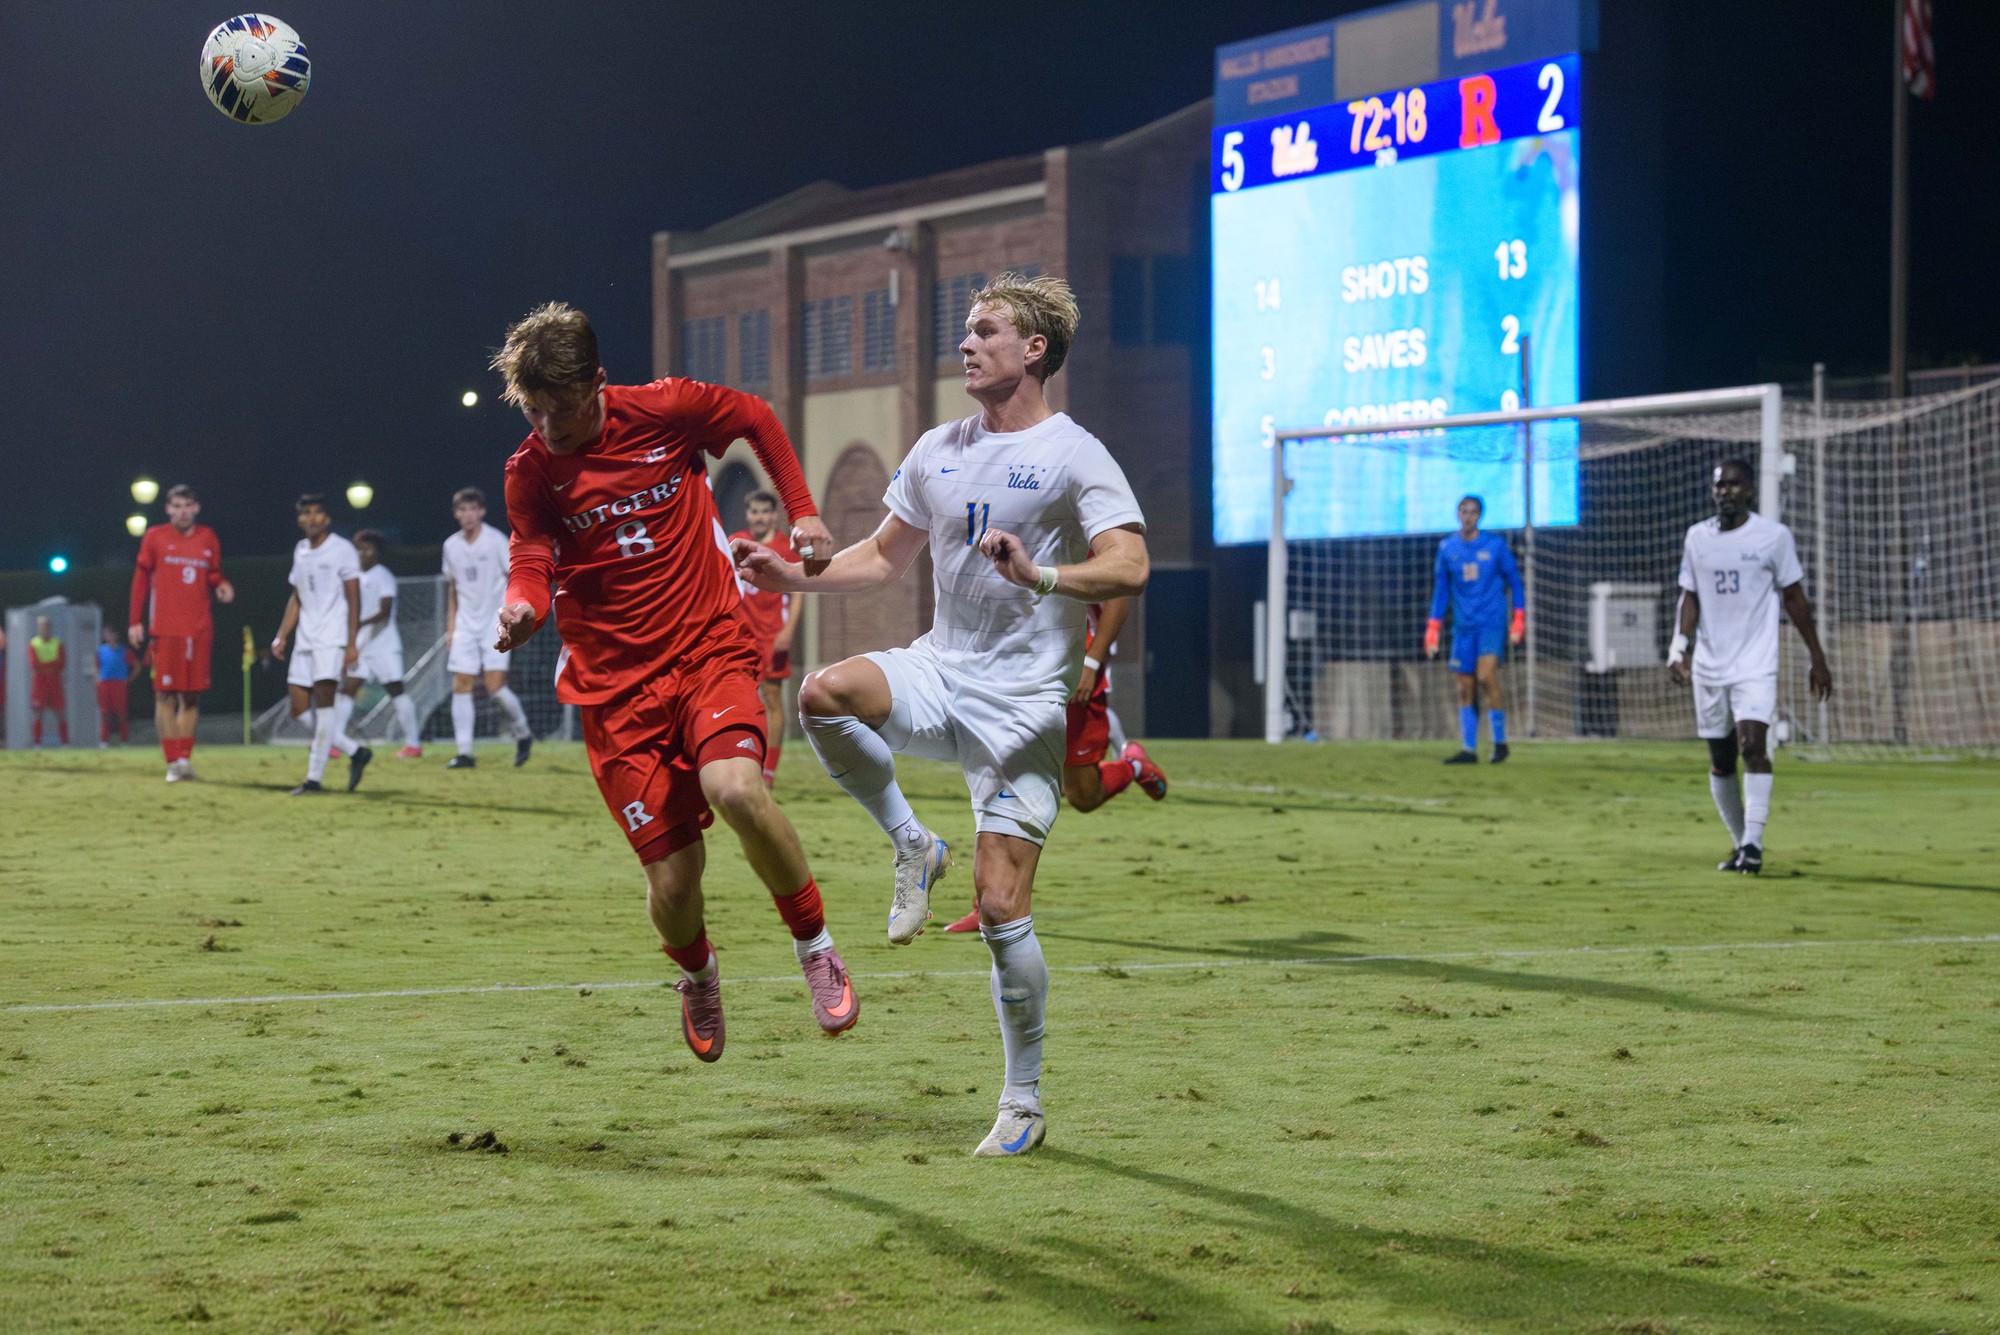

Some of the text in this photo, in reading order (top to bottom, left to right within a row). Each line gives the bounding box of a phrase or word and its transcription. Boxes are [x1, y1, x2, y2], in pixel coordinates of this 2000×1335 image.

[1221, 131, 1245, 191] 5
[1347, 88, 1427, 154] 72:18
[1459, 75, 1501, 148] R
[1537, 63, 1564, 132] 2
[1254, 238, 1528, 312] 14 SHOTS 13
[1260, 315, 1519, 380] 3 SAVES 2
[1260, 415, 1274, 449] 5
[615, 519, 655, 558] 8
[965, 501, 990, 547] 11
[182, 566, 197, 585] 9
[1714, 570, 1740, 595] 23
[622, 800, 654, 832] R
